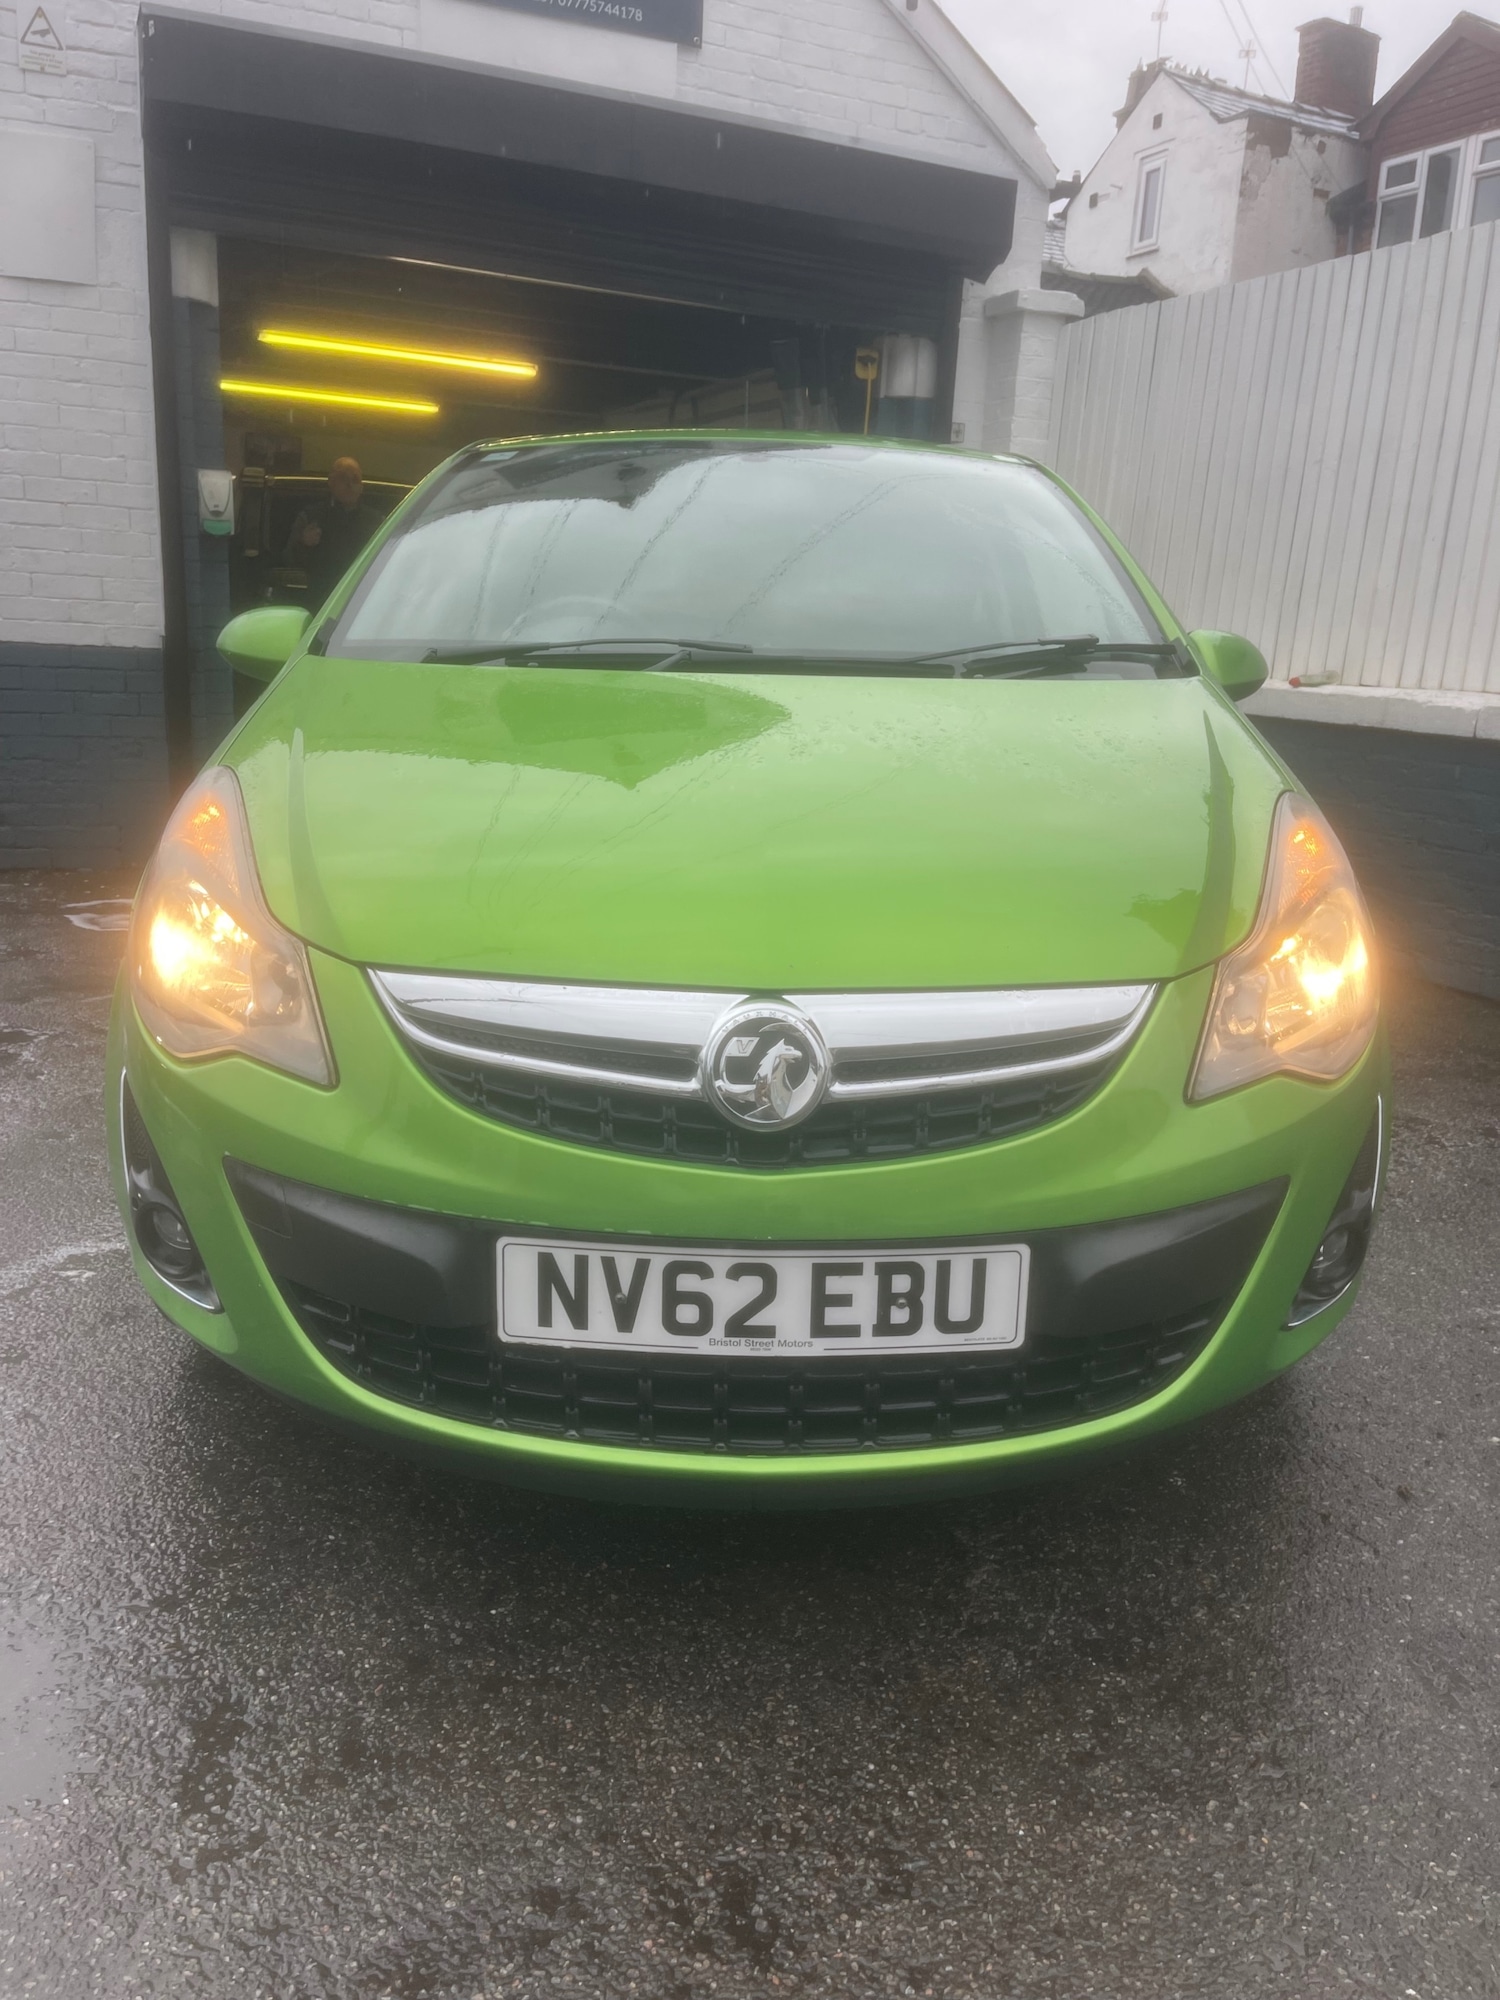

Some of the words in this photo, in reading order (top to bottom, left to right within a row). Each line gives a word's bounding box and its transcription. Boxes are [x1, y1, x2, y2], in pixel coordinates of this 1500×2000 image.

[721, 1010, 808, 1035] VAUXHALL
[537, 1252, 778, 1338] NV62
[810, 1258, 988, 1338] EBU
[708, 1338, 741, 1347] Bristol
[744, 1338, 774, 1348] Street
[777, 1339, 813, 1348] Motors
